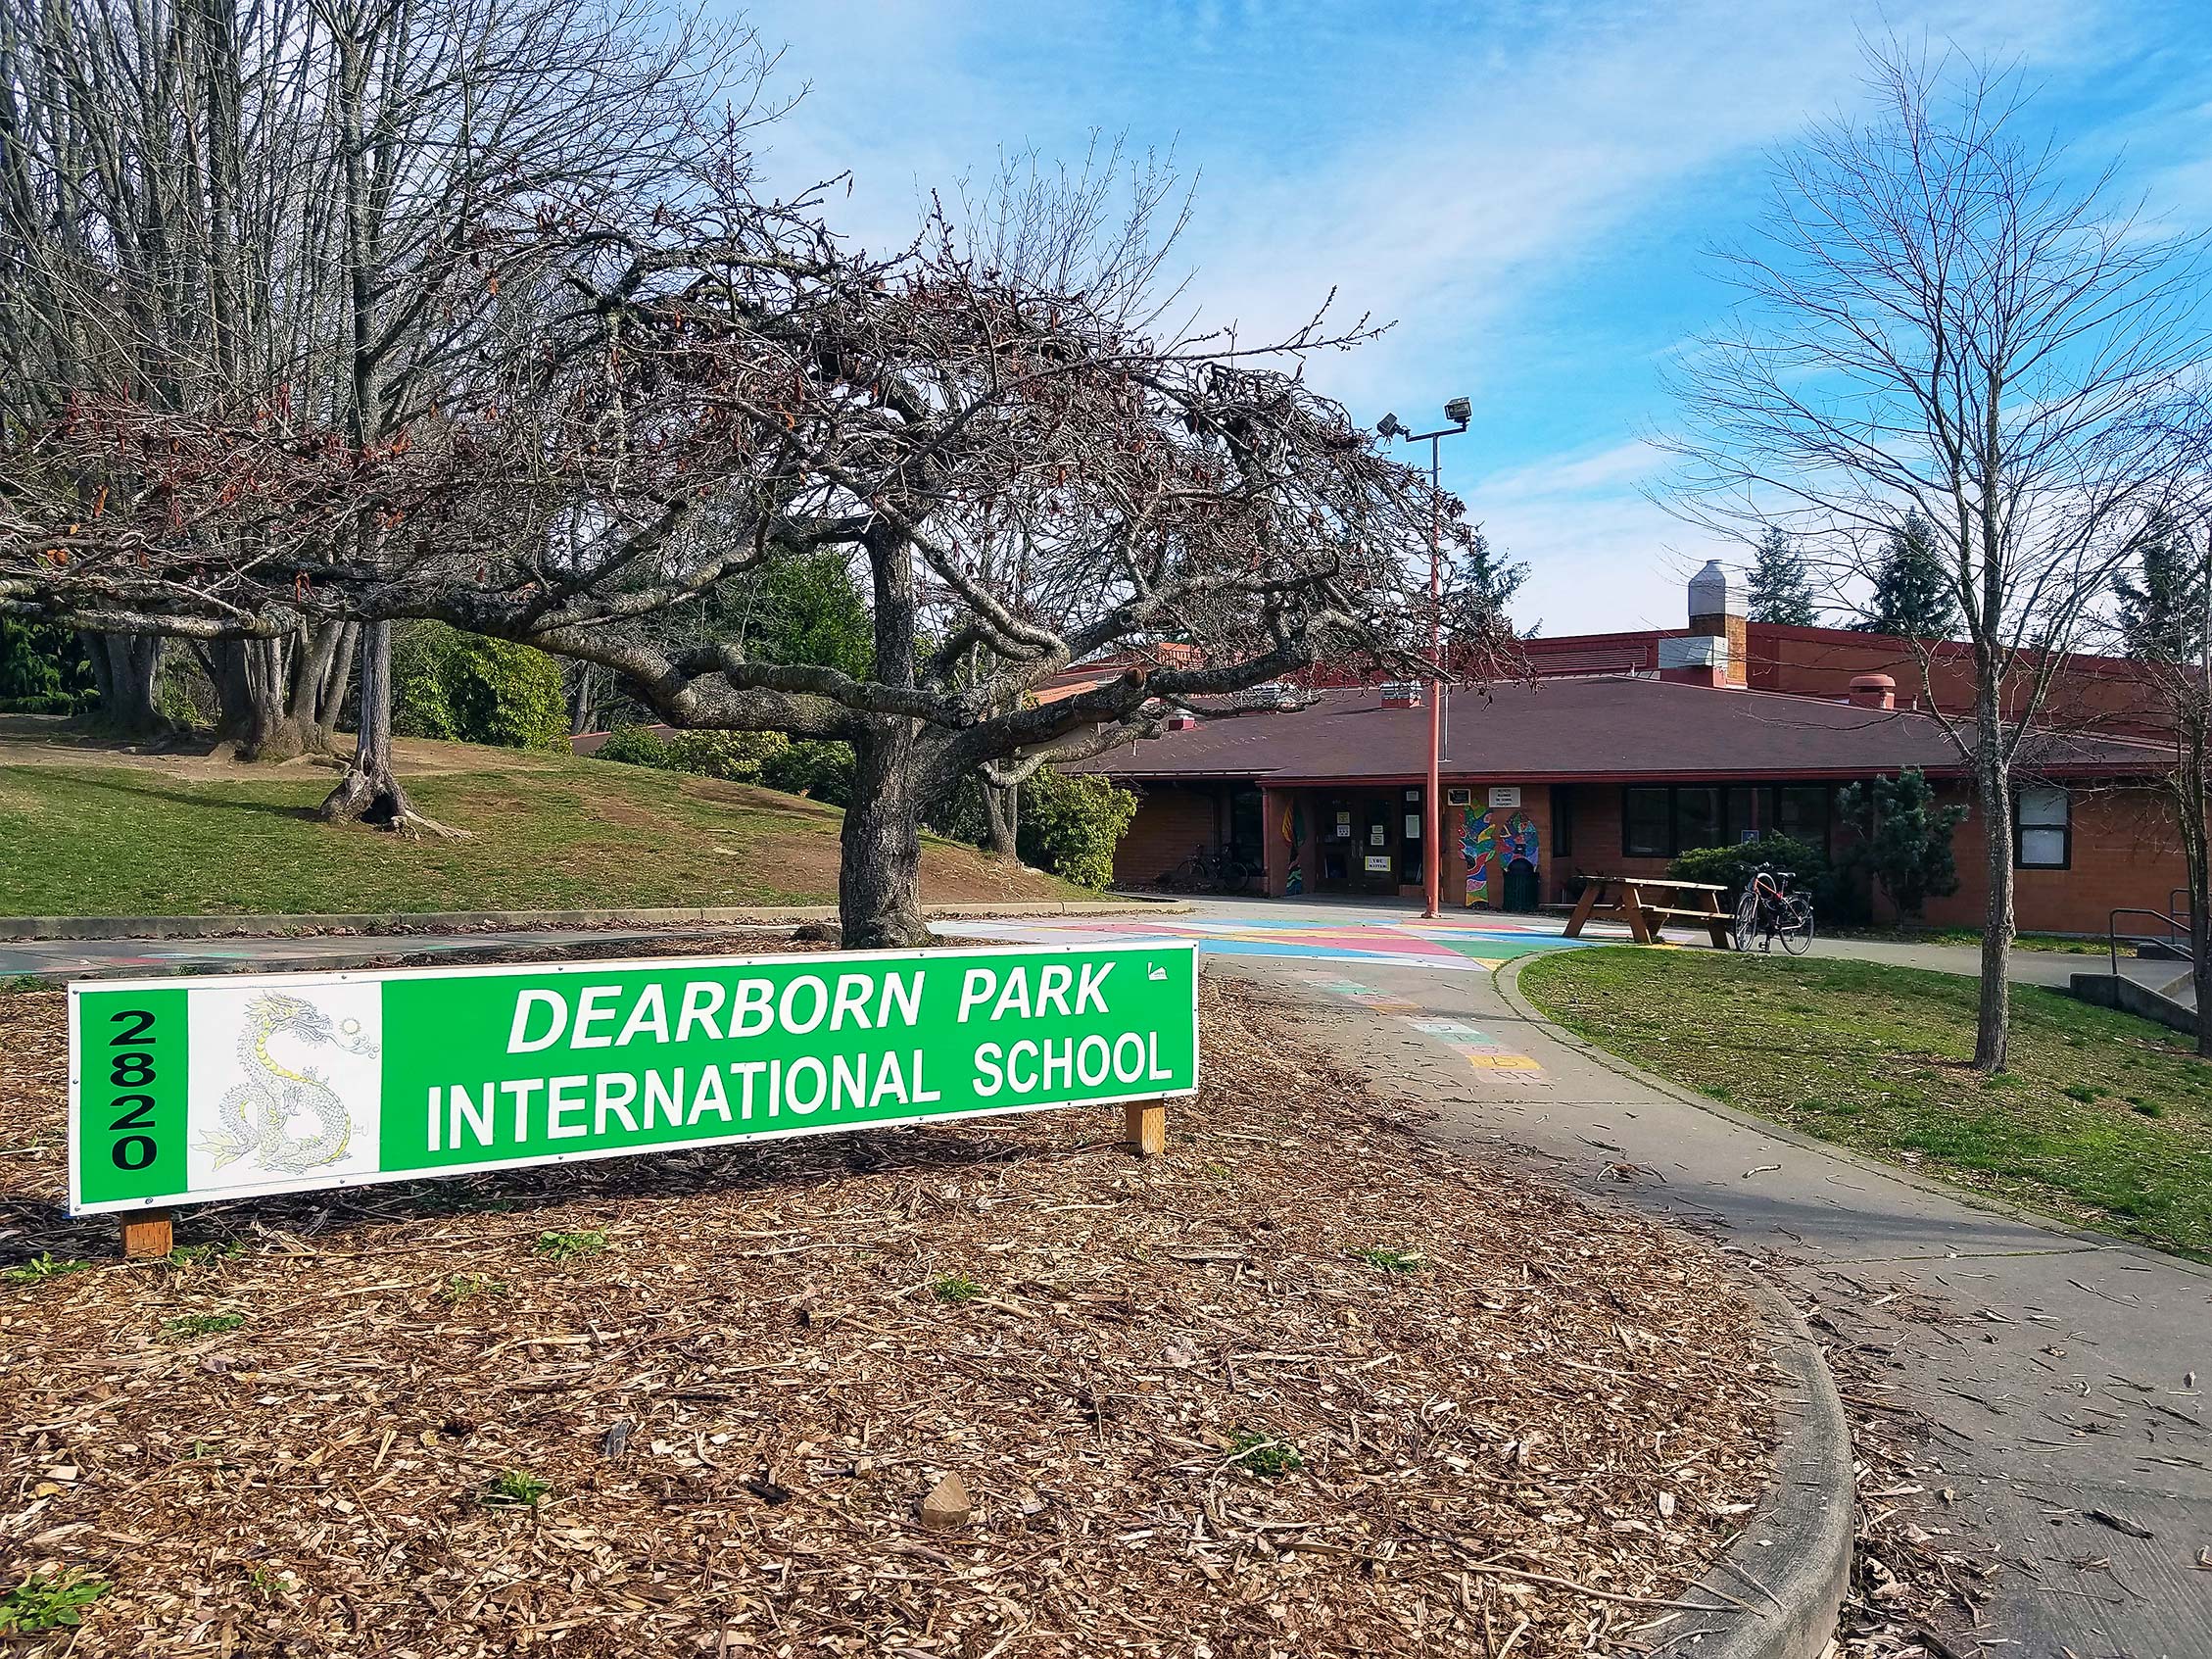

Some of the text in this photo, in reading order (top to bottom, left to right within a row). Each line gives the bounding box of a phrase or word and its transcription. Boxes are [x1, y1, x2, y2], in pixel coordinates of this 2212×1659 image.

[506, 961, 1116, 1054] DEARBORN PARK
[109, 1009, 158, 1171] 2820
[427, 1031, 1173, 1152] INTERNATIONAL SCHOOL
